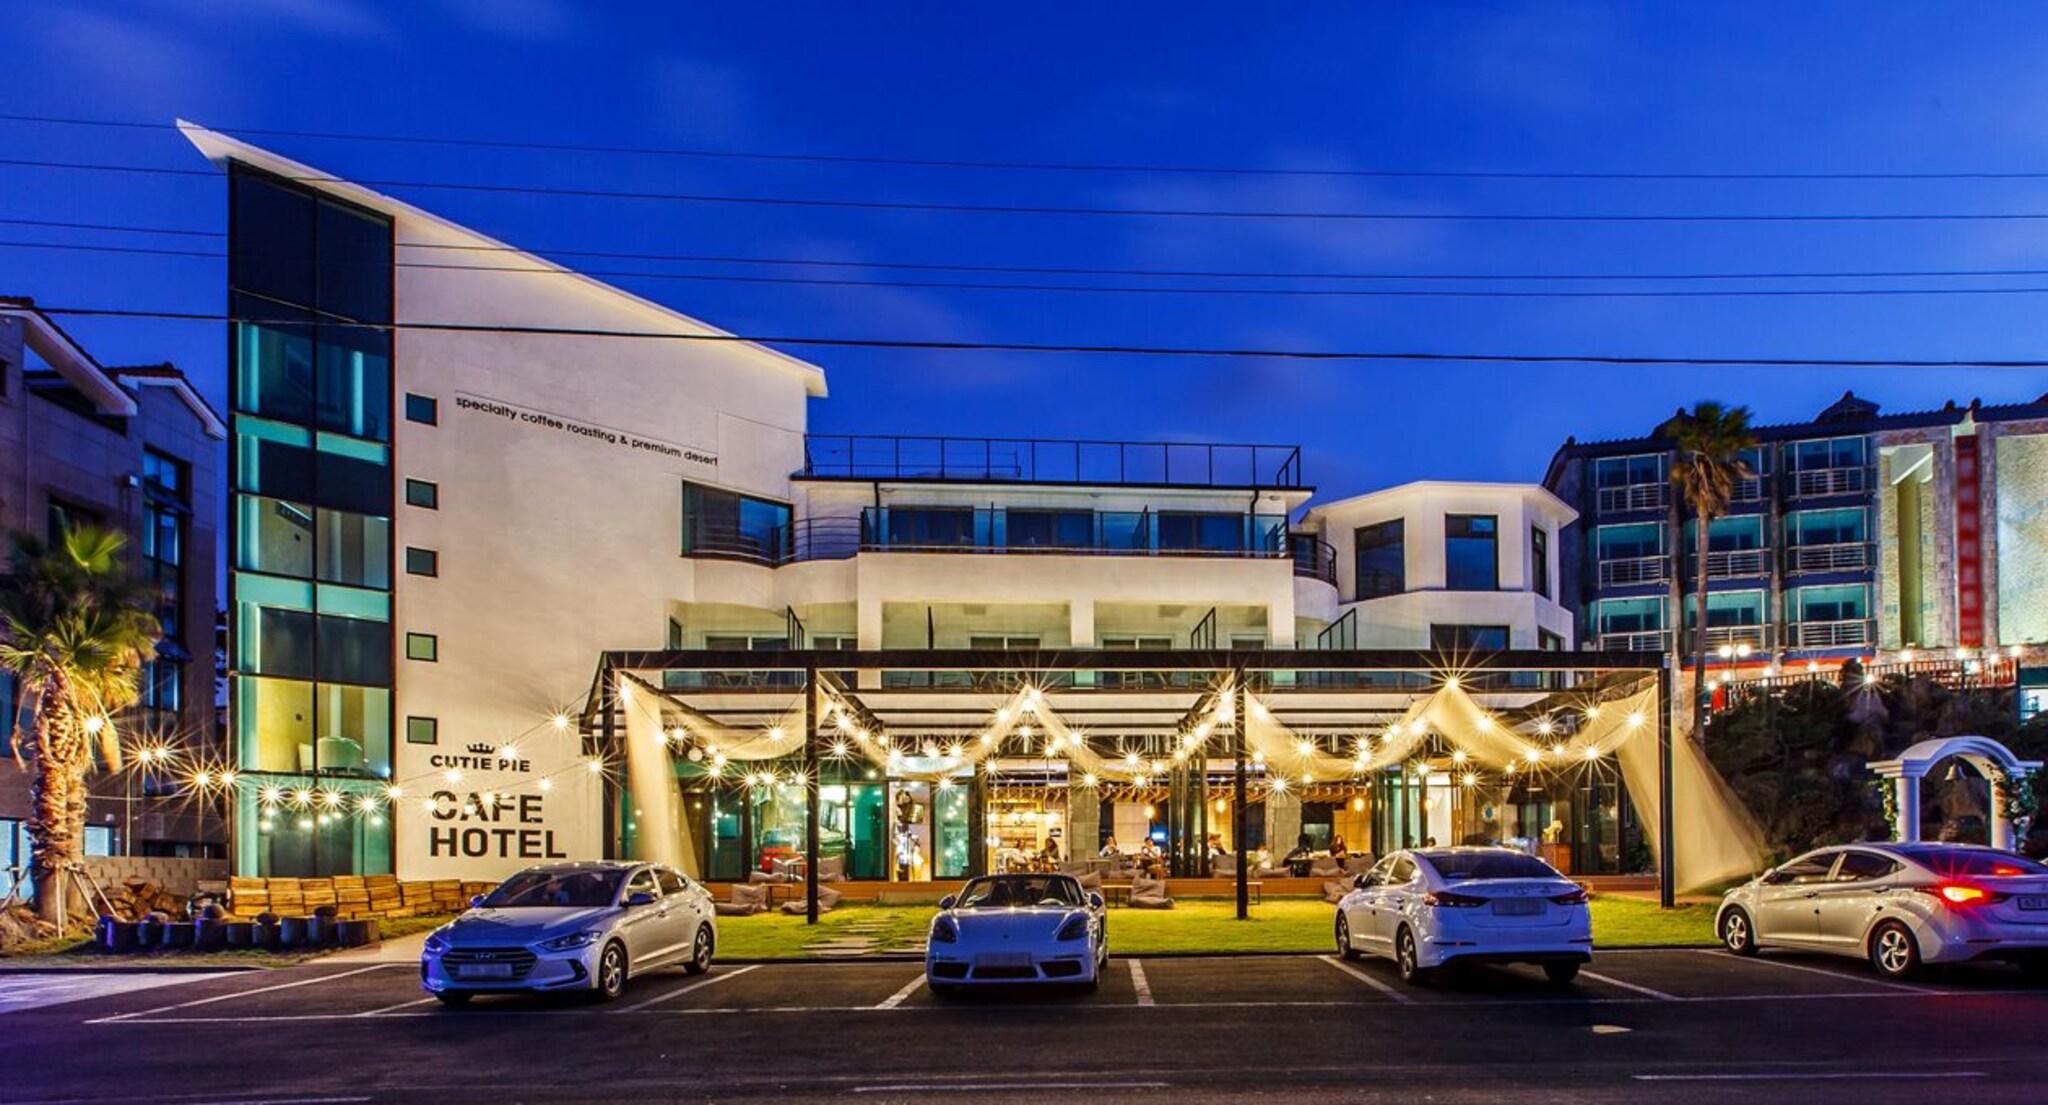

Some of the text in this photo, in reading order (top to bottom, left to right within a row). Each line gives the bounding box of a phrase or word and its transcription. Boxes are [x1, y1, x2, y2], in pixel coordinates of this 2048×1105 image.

[456, 396, 718, 467] specialty coffee roasting & premium desert
[430, 754, 531, 772] CUTIE PIE
[431, 791, 543, 823] CAFE
[430, 827, 567, 859] HOTEL
